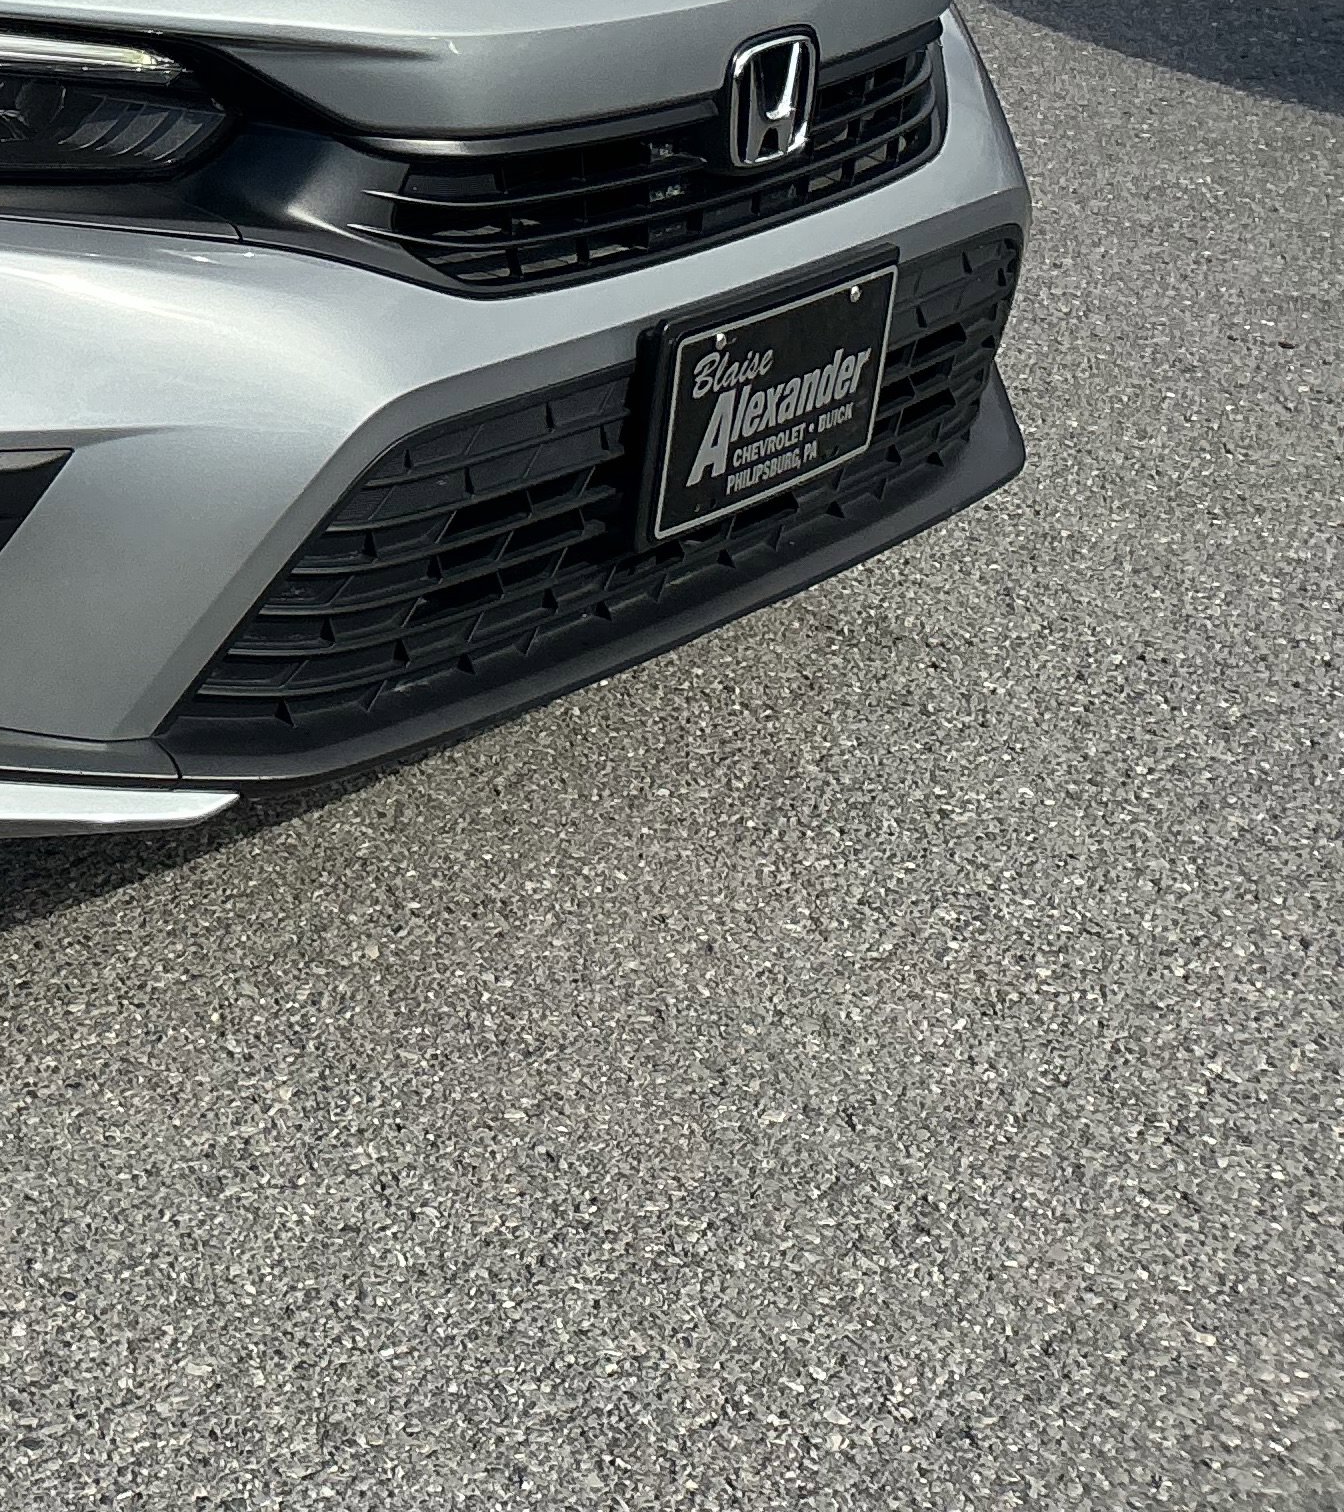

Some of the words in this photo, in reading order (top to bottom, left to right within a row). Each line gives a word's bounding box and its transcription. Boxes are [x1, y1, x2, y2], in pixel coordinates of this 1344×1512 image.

[692, 349, 774, 399] Blaise
[686, 347, 872, 487] Alexander
[733, 422, 807, 467] CHEVROLET
[818, 402, 854, 433] BUICK
[803, 440, 818, 464] PA
